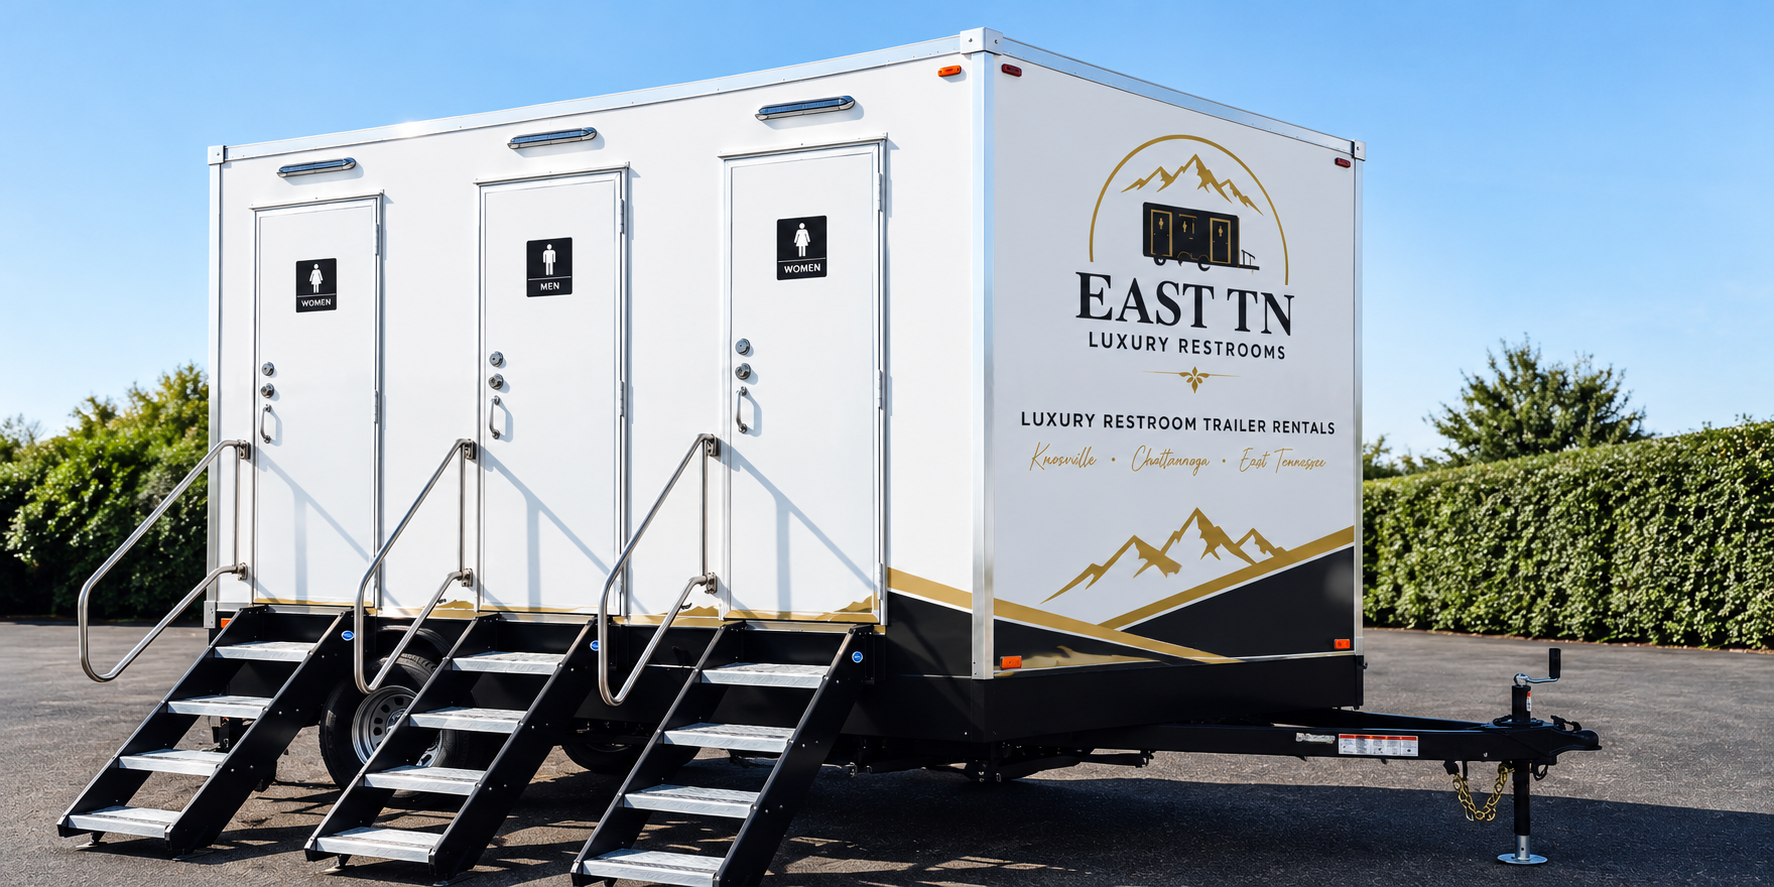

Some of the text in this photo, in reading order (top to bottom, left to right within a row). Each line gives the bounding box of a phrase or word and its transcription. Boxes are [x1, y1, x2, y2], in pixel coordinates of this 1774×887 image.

[784, 263, 821, 274] WOMEN
[540, 281, 560, 291] MEN
[301, 298, 332, 307] WOMEN
[1075, 271, 1295, 336] EAST TN
[1088, 331, 1286, 360] LUXURY RESTROOMS
[1021, 411, 1335, 435] LUXURY RESTROOM TRAILER RENTALS
